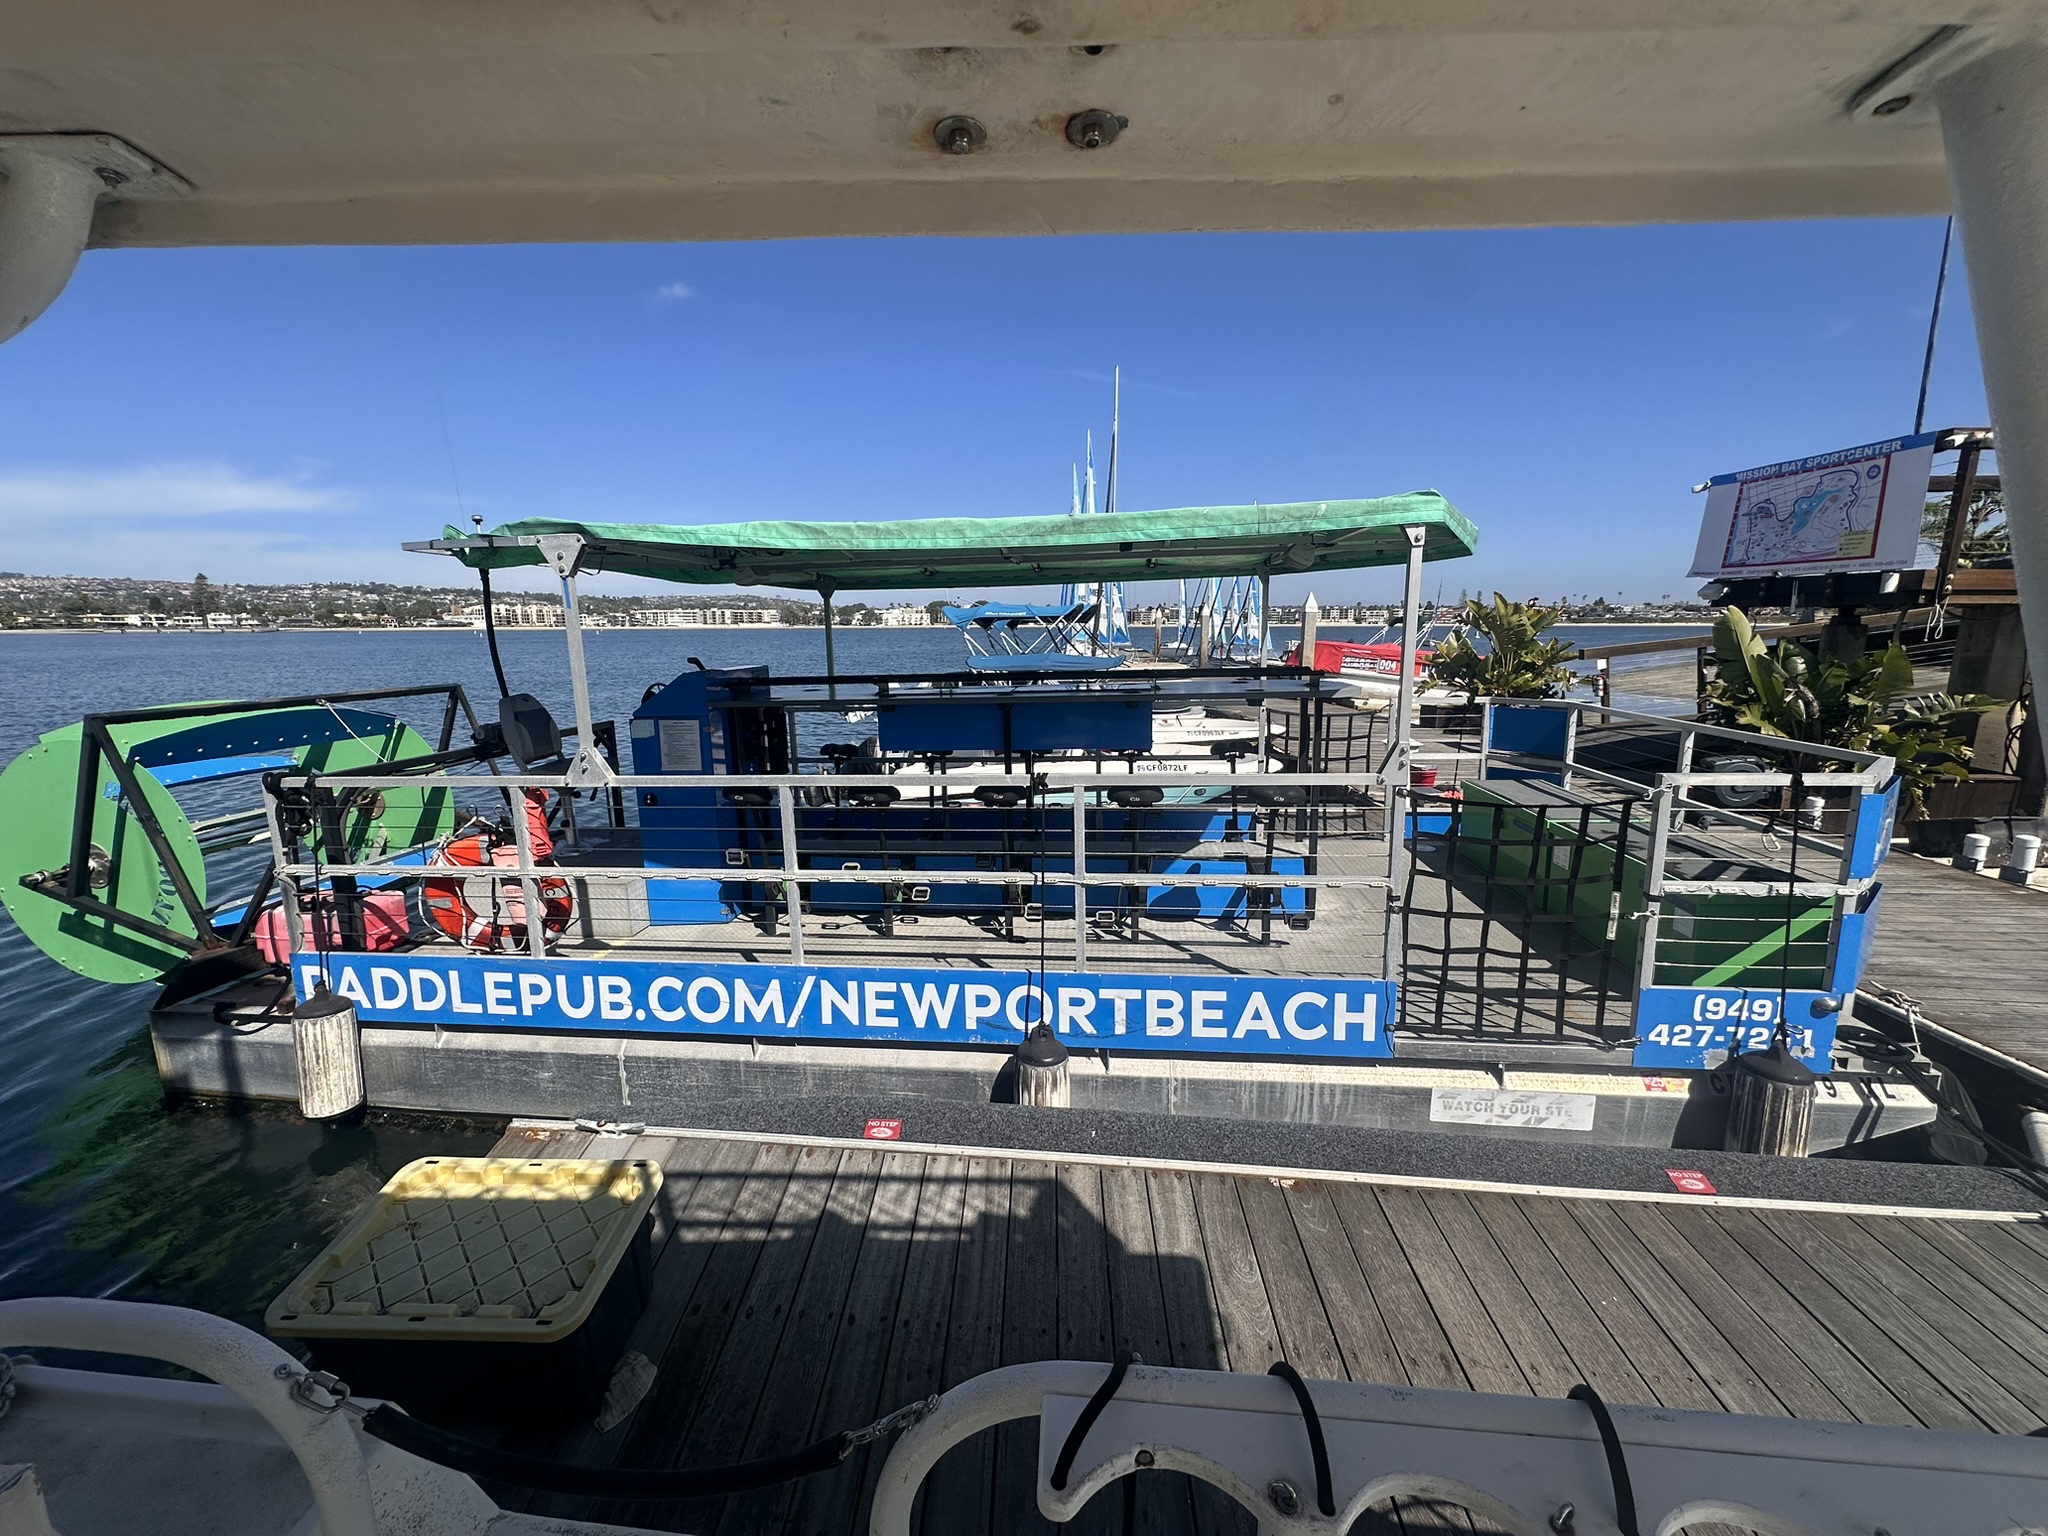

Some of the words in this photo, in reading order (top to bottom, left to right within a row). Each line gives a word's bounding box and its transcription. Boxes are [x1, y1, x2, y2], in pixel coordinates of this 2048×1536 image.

[1735, 465, 1779, 481] MISSION
[1781, 460, 1803, 474] BAY
[1805, 440, 1902, 468] SPORTCENTER
[1379, 659, 1397, 671] 004
[1146, 763, 1188, 772] CF0872LF
[300, 964, 1377, 1042] PADDLEPUB.COM/NEWPORTBEACH
[1693, 993, 1781, 1024] (949)
[1648, 1023, 1813, 1050] 427-721
[1442, 1100, 1494, 1113] WATCH
[1499, 1103, 1541, 1116] YOUR
[1545, 1106, 1574, 1118] STE
